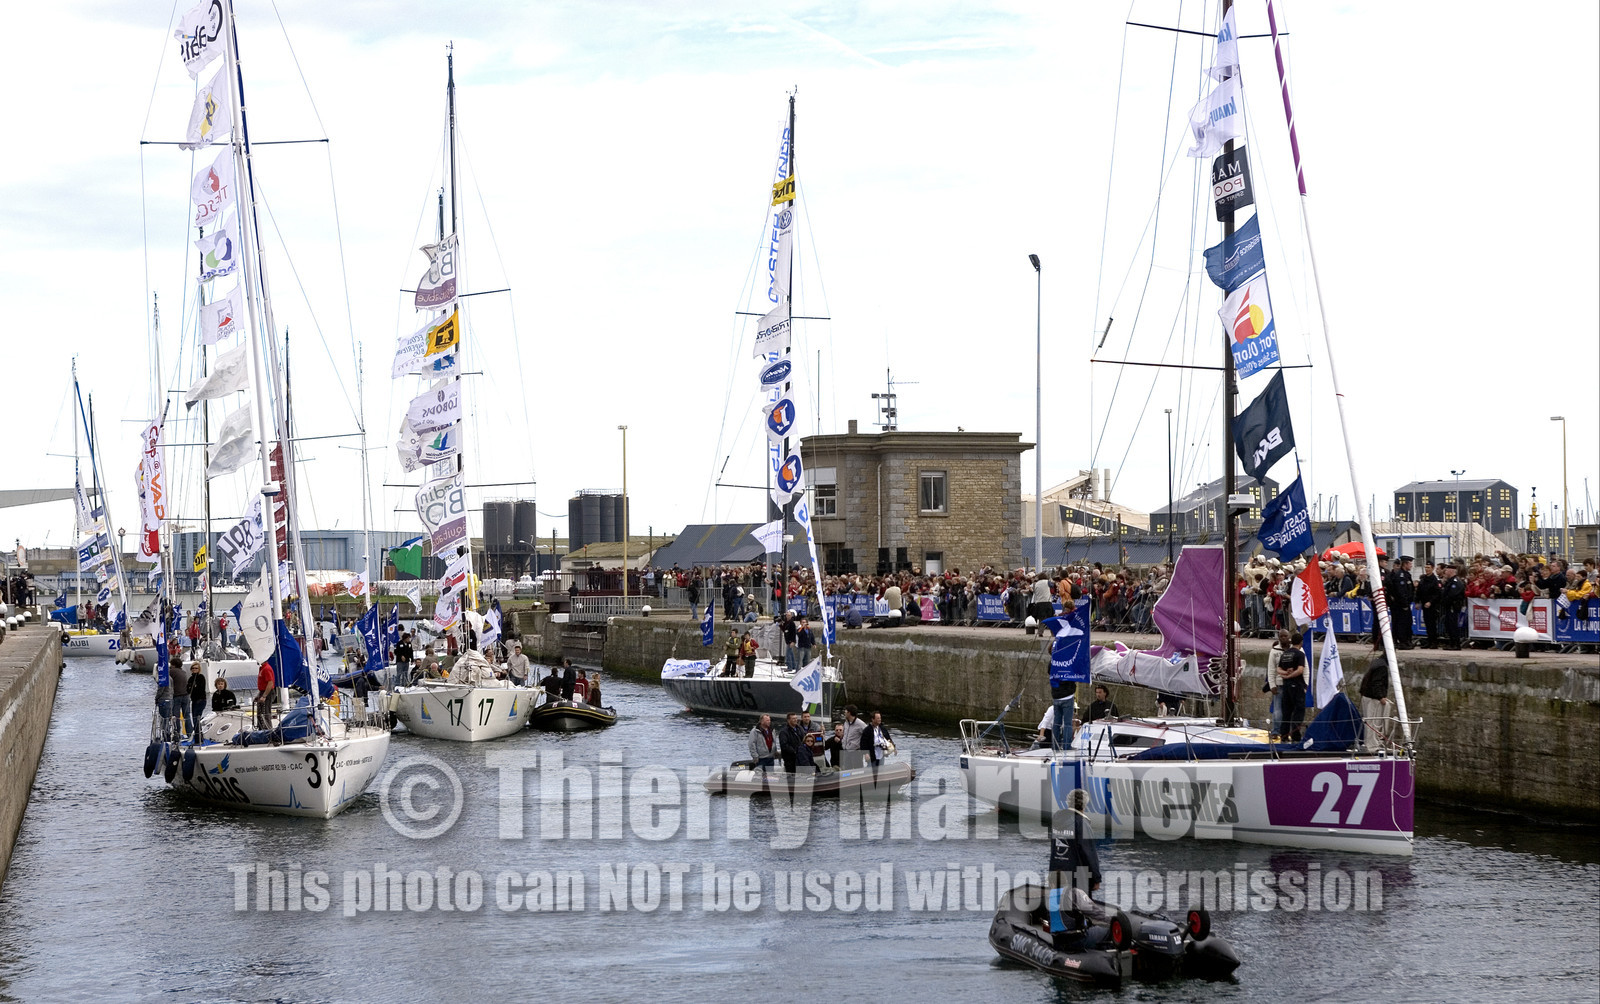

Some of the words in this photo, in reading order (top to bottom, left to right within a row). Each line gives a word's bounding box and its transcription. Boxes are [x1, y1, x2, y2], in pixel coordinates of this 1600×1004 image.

[151, 473, 165, 520] VAD
[1328, 600, 1359, 611] Guadeloupe
[447, 699, 463, 726] 17
[478, 698, 494, 726] 17
[290, 762, 303, 770] CAC
[305, 752, 322, 789] 3
[327, 751, 338, 787] 3
[1310, 772, 1380, 826] 27
[1010, 933, 1030, 955] SMC
[1148, 933, 1168, 942] YAMAHA
